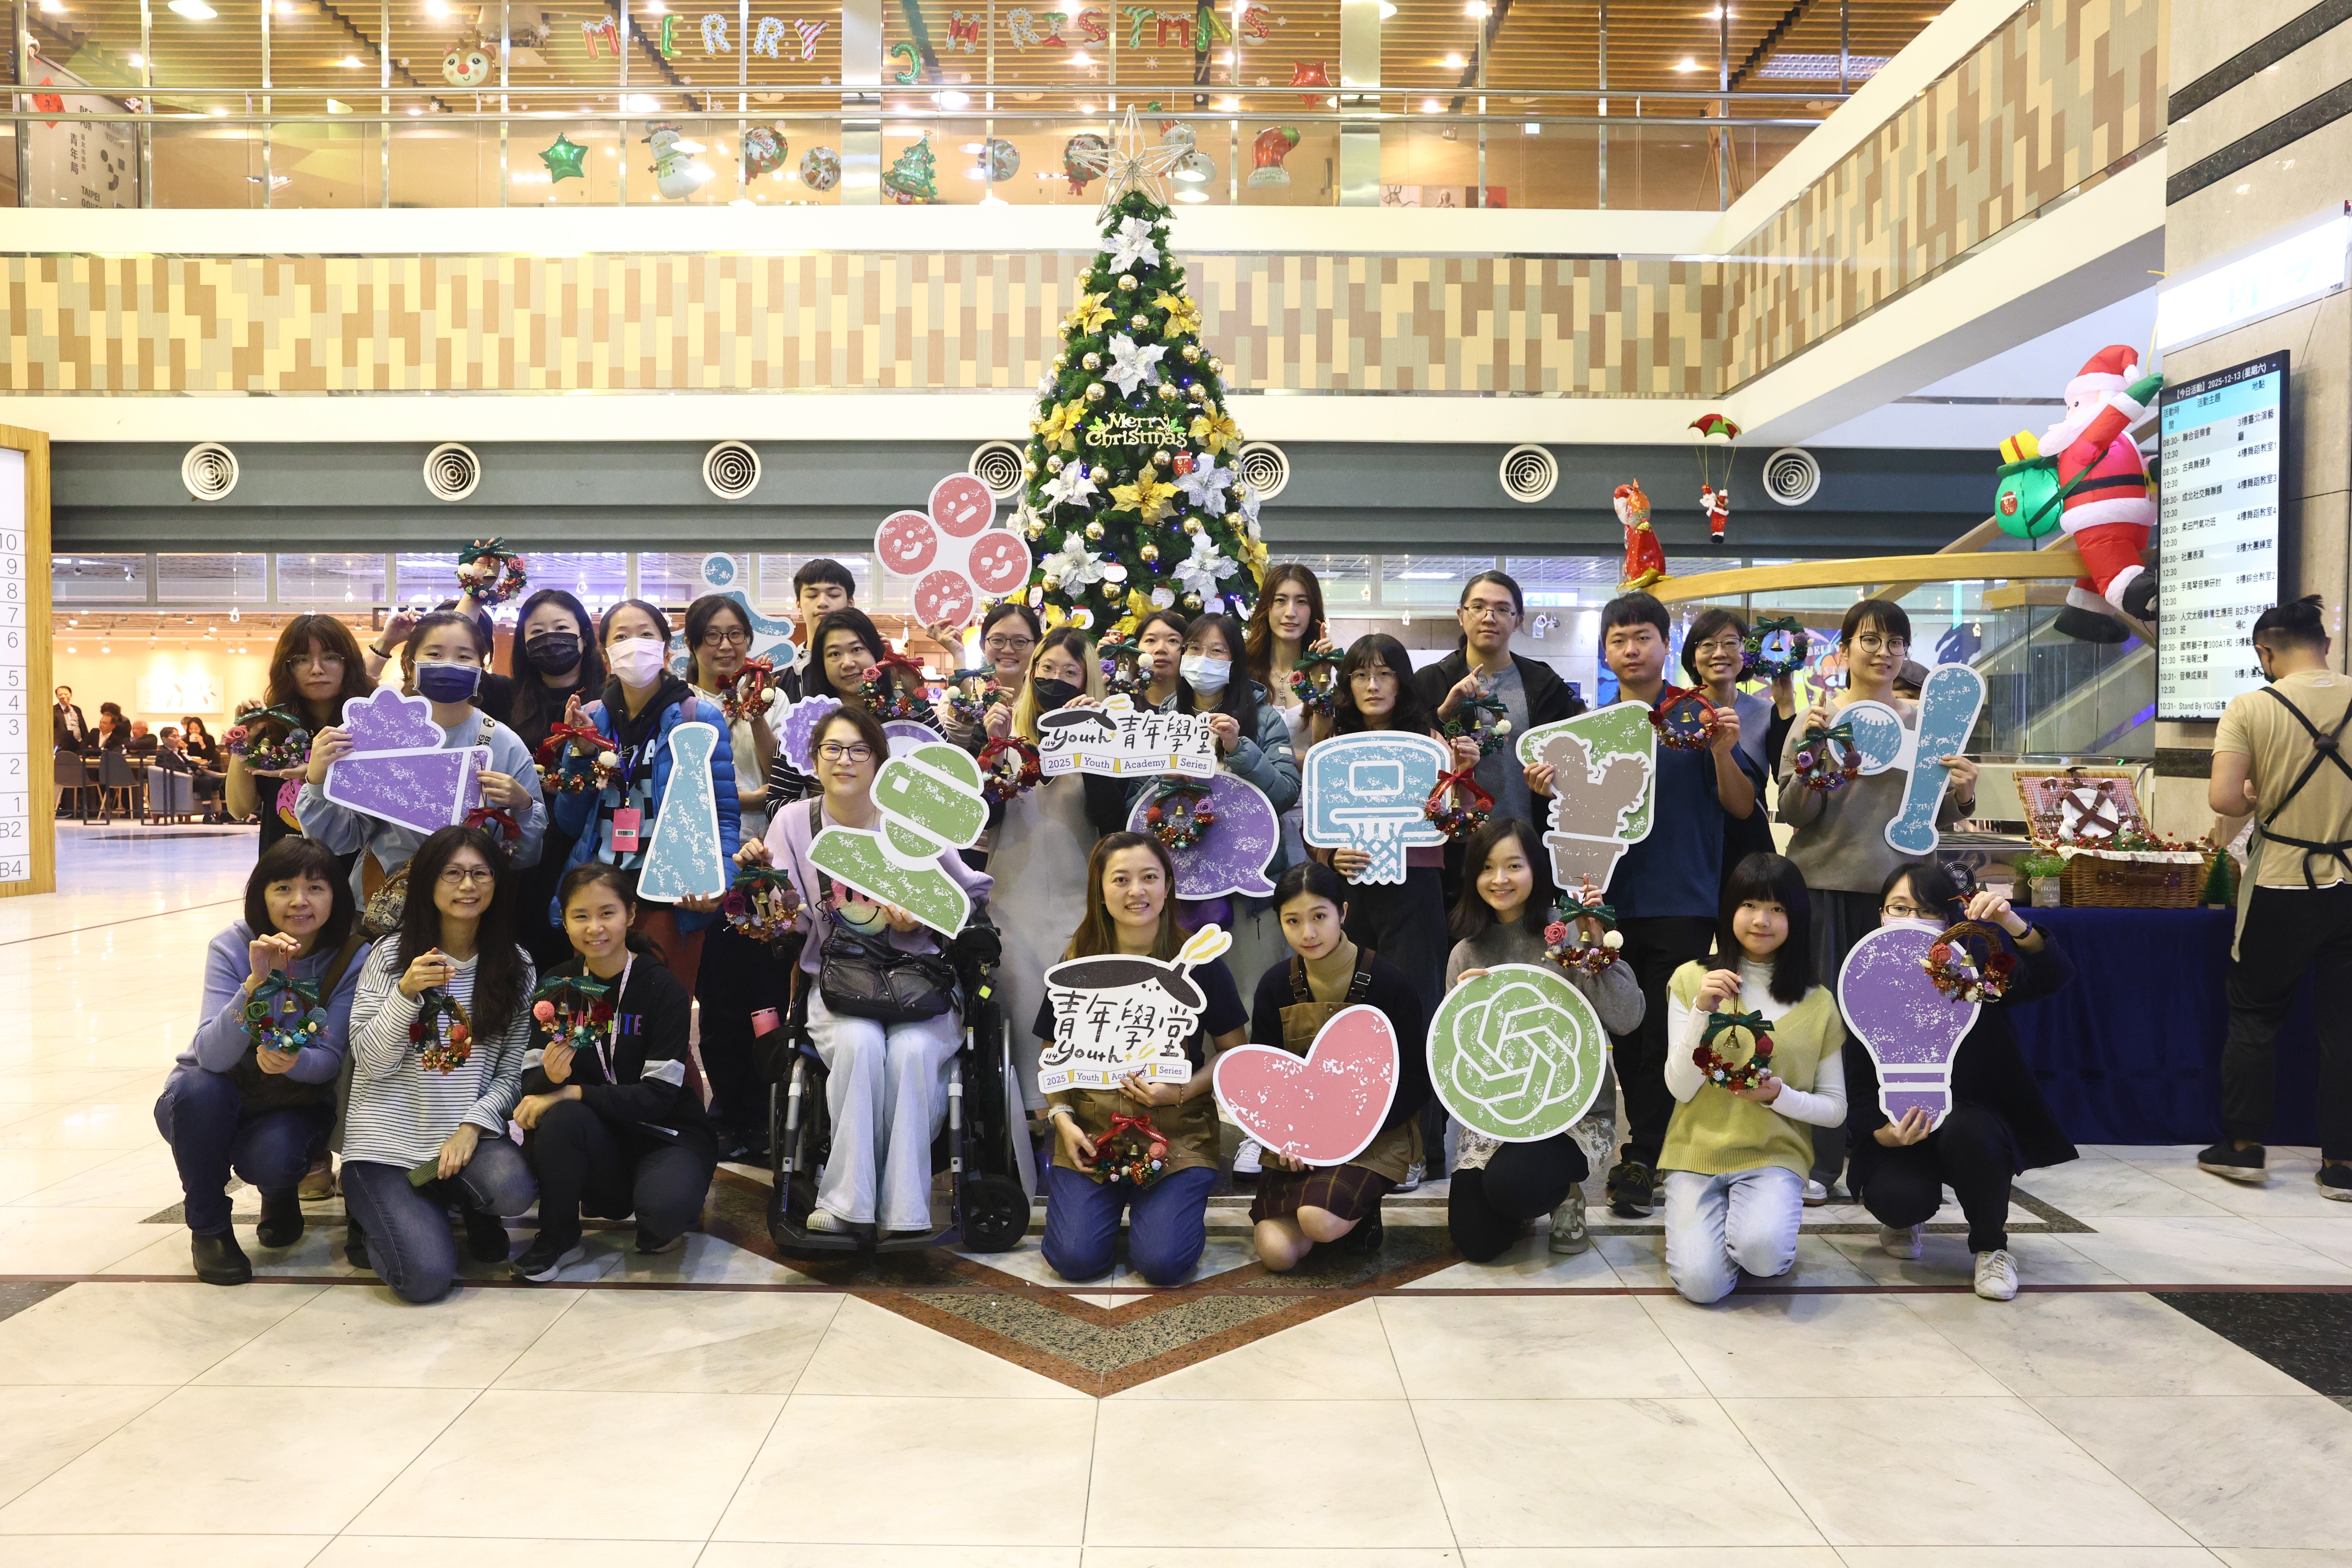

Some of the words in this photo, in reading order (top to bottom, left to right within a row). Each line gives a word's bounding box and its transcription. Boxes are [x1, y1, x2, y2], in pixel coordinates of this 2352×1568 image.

[581, 14, 830, 63] MERRY
[70, 132, 78, 175] 青年局
[81, 185, 100, 202] TAIPEI
[2208, 373, 2241, 389] 2025-12-13
[2242, 363, 2267, 380] (星期六)
[2252, 379, 2265, 391] 地點
[2197, 393, 2221, 408] 活動主題
[2163, 405, 2180, 419] 活動時
[2238, 408, 2274, 427] 3樓臺北演藝
[1108, 412, 1170, 432] Merry
[1085, 430, 1188, 448] Christmas
[2182, 426, 2211, 442] 聯合音樂會
[2163, 437, 2179, 447] 08:30-
[2164, 450, 2178, 460] 12:30
[2238, 442, 2277, 458] 4樓舞蹈教室1
[2163, 466, 2179, 477] 08:30-
[2182, 457, 2211, 472] 古典舞健身
[2164, 479, 2178, 489] 12:30
[2237, 474, 2277, 490] 4樓舞蹈教室3
[2162, 495, 2179, 505] 08:30-
[2163, 508, 2178, 519] 12:30
[2237, 506, 2276, 521] 4樓舞蹈教室4
[2162, 526, 2178, 535] 08:30-
[2163, 538, 2177, 548] 12:30
[2237, 539, 2273, 553] 8樓大團練室
[2161, 554, 2178, 564] 08:30-
[2181, 550, 2204, 562] 社團表演
[7, 559, 16, 574] 9
[2163, 568, 2177, 577] 12:30
[2181, 577, 2221, 592] 手風琴音樂研討
[2236, 572, 2276, 584] 8樓綜合教室2
[7, 583, 17, 599] 8
[2161, 584, 2178, 593] 08:30-
[2162, 597, 2176, 606] 12:30
[8, 608, 18, 623] 7
[2161, 614, 2177, 622] 08:30-
[2162, 627, 2176, 635] 12:30
[2180, 625, 2186, 634] 班
[2236, 621, 2246, 630] 場C
[8, 632, 18, 648] 6
[2180, 638, 2232, 651] 國際獅子會300A1和
[2235, 637, 2254, 647] 5樓藝
[9, 671, 18, 686] 5
[2160, 673, 2176, 681] 10:31-
[2180, 671, 2208, 681] 音樂成果展
[9, 695, 19, 710] 4
[2195, 702, 2202, 712] By
[9, 719, 19, 735] 3
[1118, 714, 1212, 753] 青年學堂
[592, 737, 614, 747] XIABENHOW
[10, 759, 20, 774] 2
[1048, 758, 1071, 769] 2025
[1084, 757, 1110, 769] Youth
[1124, 759, 1166, 769] Academy
[1180, 758, 1207, 769] Series
[14, 797, 19, 812] 1
[0, 821, 21, 838] B2
[0, 860, 22, 877] B4
[1593, 909, 1615, 921] XIABENHOW
[1053, 990, 1192, 1057] 青年學堂
[1046, 1076, 1066, 1086] 2025
[1076, 1073, 1099, 1082] Youth
[1159, 1066, 1183, 1075] Series
